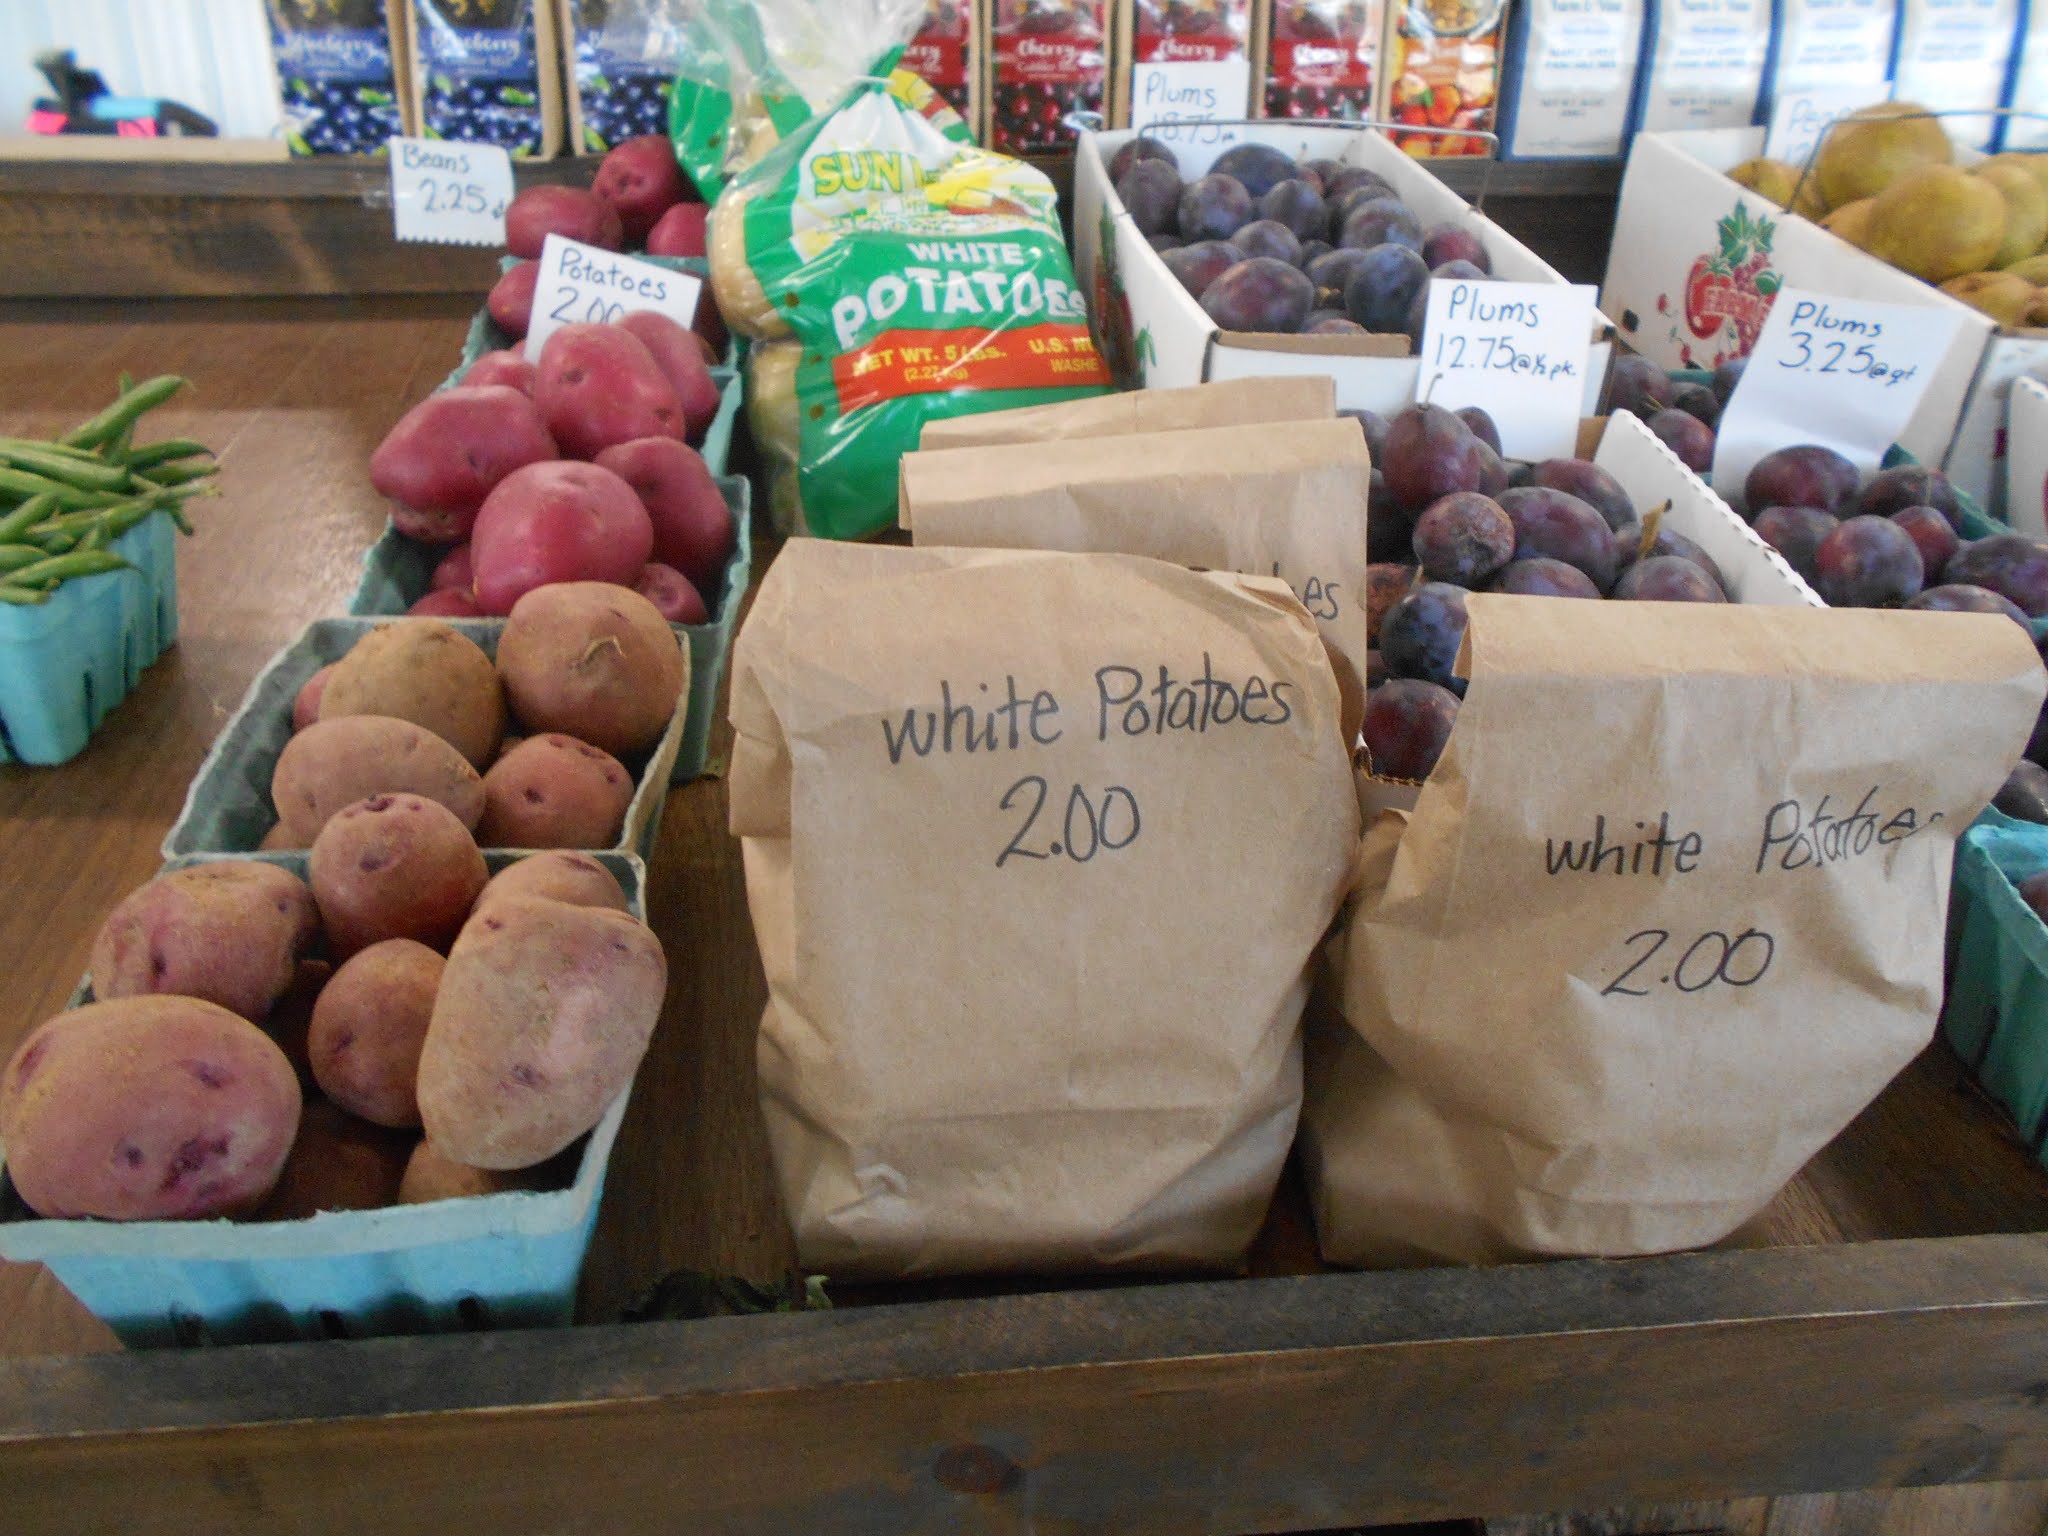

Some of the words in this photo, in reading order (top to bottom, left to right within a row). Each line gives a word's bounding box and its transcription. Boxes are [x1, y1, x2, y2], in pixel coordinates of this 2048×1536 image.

[1146, 71, 1217, 109] Plums
[403, 143, 470, 174] Beans
[418, 177, 488, 215] 2.25
[906, 242, 1024, 265] WHITE
[559, 246, 667, 301] Potatoes
[831, 267, 1087, 350] POTATOES
[1449, 284, 1539, 328] Plums
[1790, 301, 1883, 338] Plums
[900, 347, 940, 363] WT.
[1028, 337, 1069, 354] U.S.
[1050, 358, 1099, 373] WASHE
[881, 674, 1063, 764] white
[1095, 651, 1294, 742] Potatoes
[995, 775, 1141, 868] 2.00
[1545, 811, 1702, 877] white
[1600, 928, 1774, 996] 2.00
